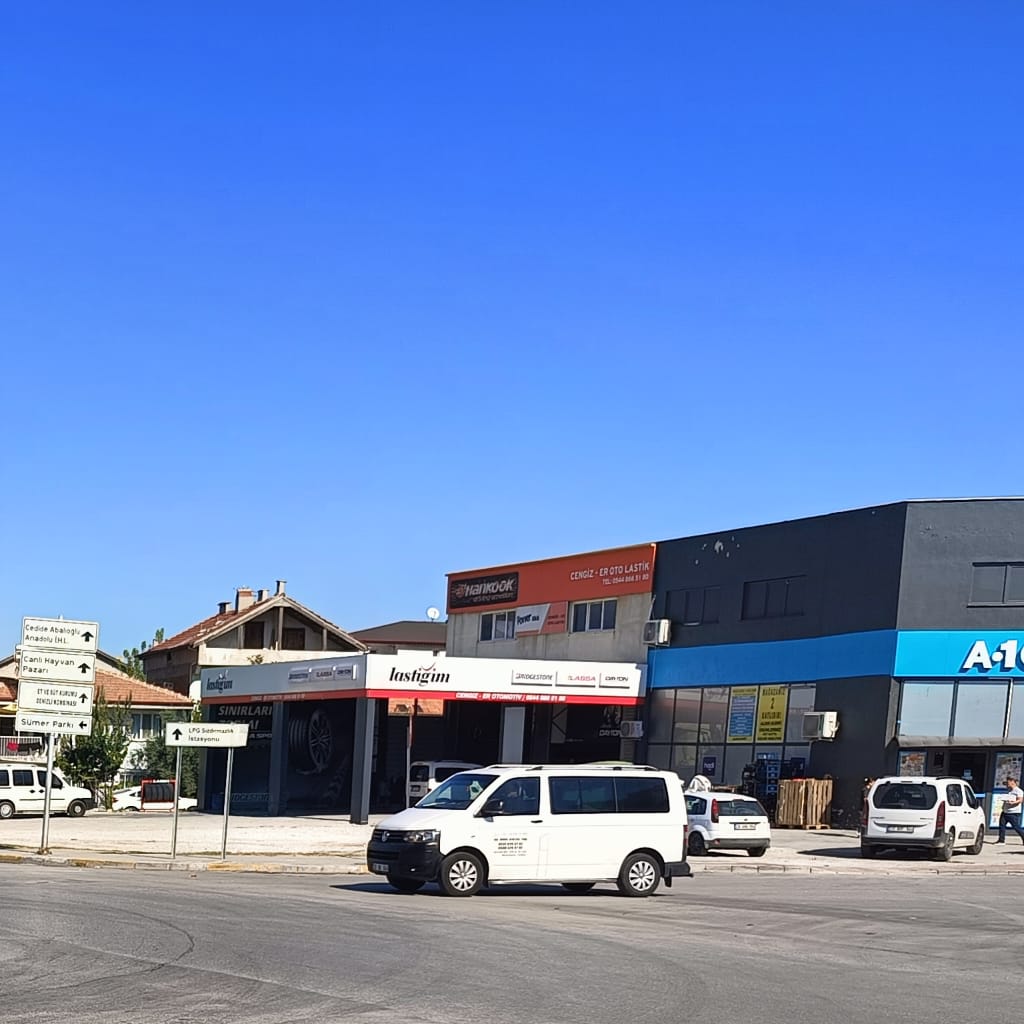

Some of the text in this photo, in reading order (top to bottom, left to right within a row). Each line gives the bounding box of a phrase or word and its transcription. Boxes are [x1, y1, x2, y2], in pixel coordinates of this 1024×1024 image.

[599, 567, 609, 577] ER
[609, 565, 624, 575] OTO
[624, 560, 650, 574] LASTİK
[25, 634, 53, 643] Anadolu
[23, 655, 75, 666] Canlı Hayvan
[22, 665, 49, 674] Pazarı
[21, 718, 74, 728] Sümer Parkı
